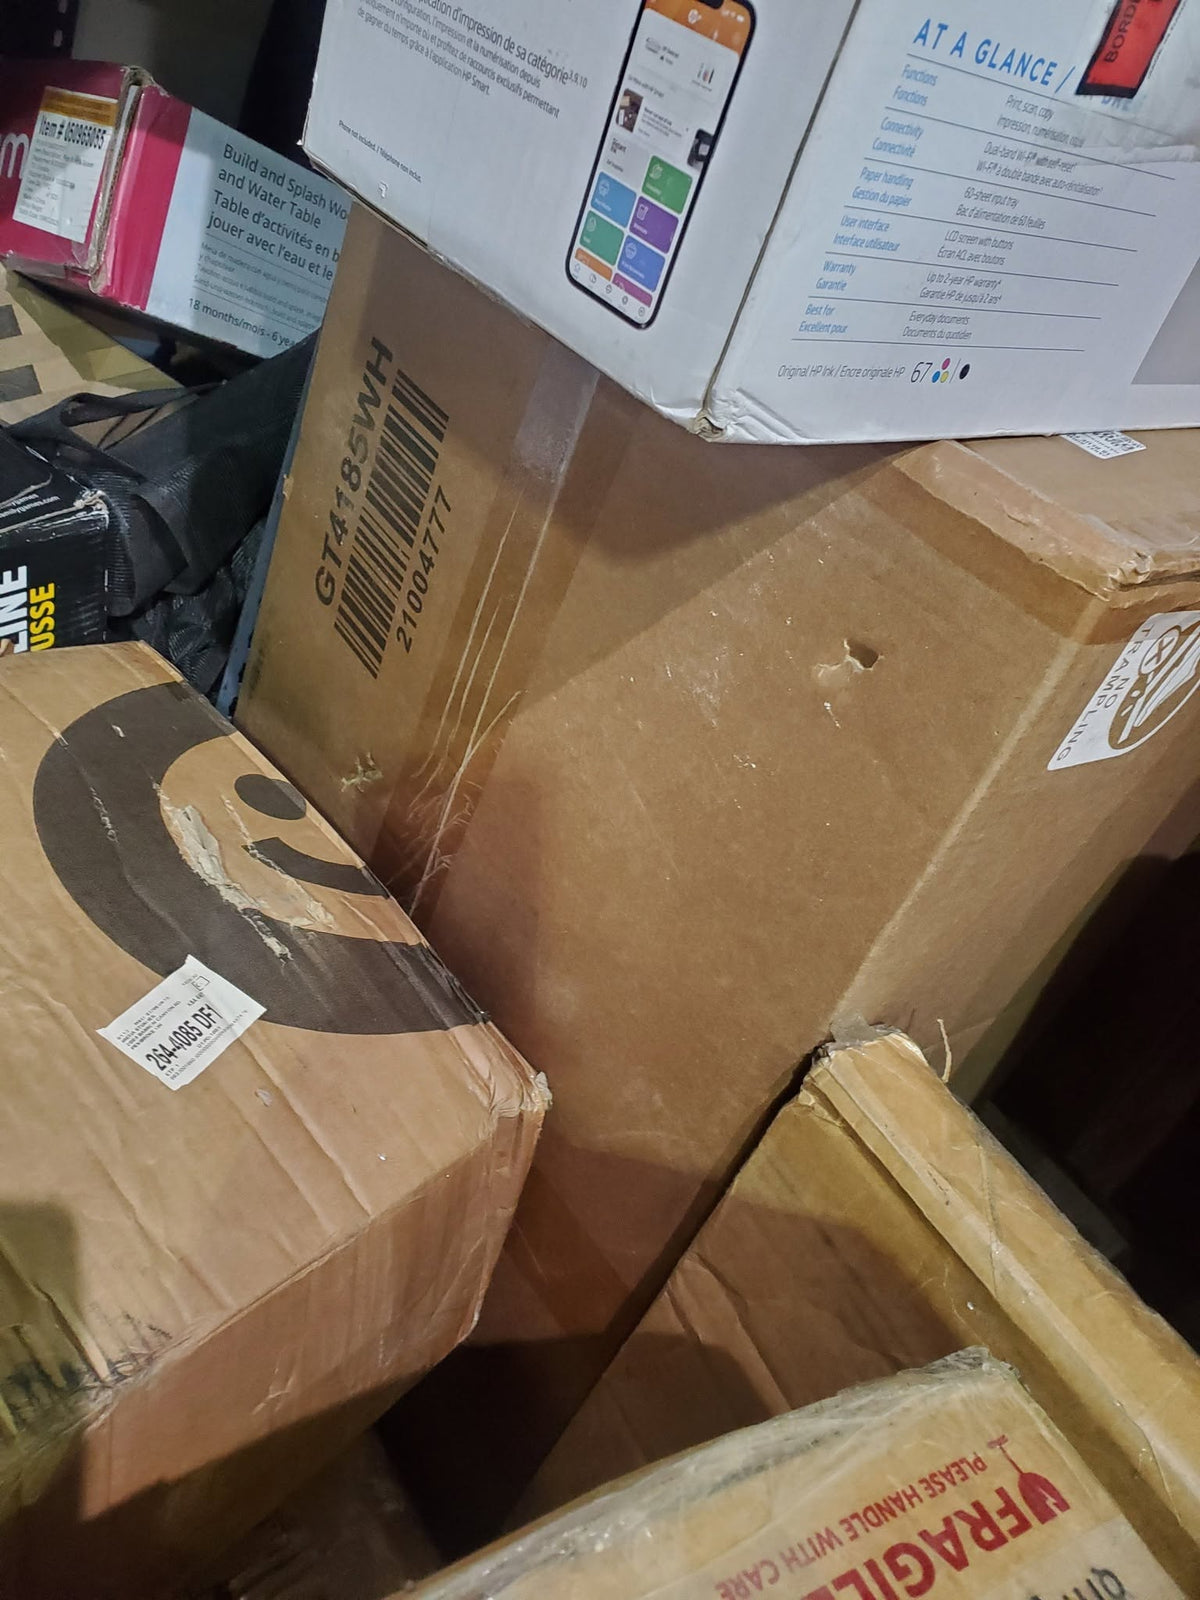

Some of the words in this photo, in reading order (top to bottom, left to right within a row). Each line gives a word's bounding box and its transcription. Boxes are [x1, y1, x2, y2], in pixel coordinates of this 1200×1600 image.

[452, 7, 503, 48] d'impression
[503, 36, 515, 54] de
[516, 45, 526, 61] sa
[913, 18, 949, 50] AT
[950, 31, 968, 59] A
[974, 38, 1058, 87] GLANCE
[1104, 0, 1140, 63] BORD
[480, 46, 519, 76] numérisation
[520, 68, 540, 88] depuis
[522, 90, 560, 118] permettant
[218, 168, 245, 190] and
[249, 180, 287, 211] Water
[290, 202, 321, 229] Table
[223, 143, 259, 173] Build
[260, 166, 286, 187] and
[287, 179, 327, 209] Splash
[206, 211, 245, 239] jouer
[246, 233, 276, 255] avec
[277, 243, 306, 269] l'eau
[308, 262, 322, 276] et
[322, 264, 334, 281] le
[213, 190, 249, 219] Table
[252, 211, 312, 250] d'activités
[315, 243, 329, 258] en
[190, 298, 200, 311] 18
[271, 331, 278, 341] 6
[777, 364, 810, 380] Original
[809, 365, 823, 377] HP
[822, 365, 835, 377] Ink
[839, 365, 862, 378] Encre
[861, 366, 894, 380] originale
[892, 366, 906, 378] HP
[910, 361, 933, 383] 67
[315, 335, 393, 607] GT4185WH
[396, 484, 452, 654] 21004777
[30, 582, 55, 652] USSE
[1057, 624, 1155, 761] TRAMPLING
[1104, 677, 1130, 708] NO
[145, 1020, 203, 1071] 264-4085
[918, 1451, 988, 1499] PLEASE
[838, 1484, 923, 1542] HANDLE
[779, 1526, 843, 1573] WITH
[714, 1559, 780, 1600] CARE
